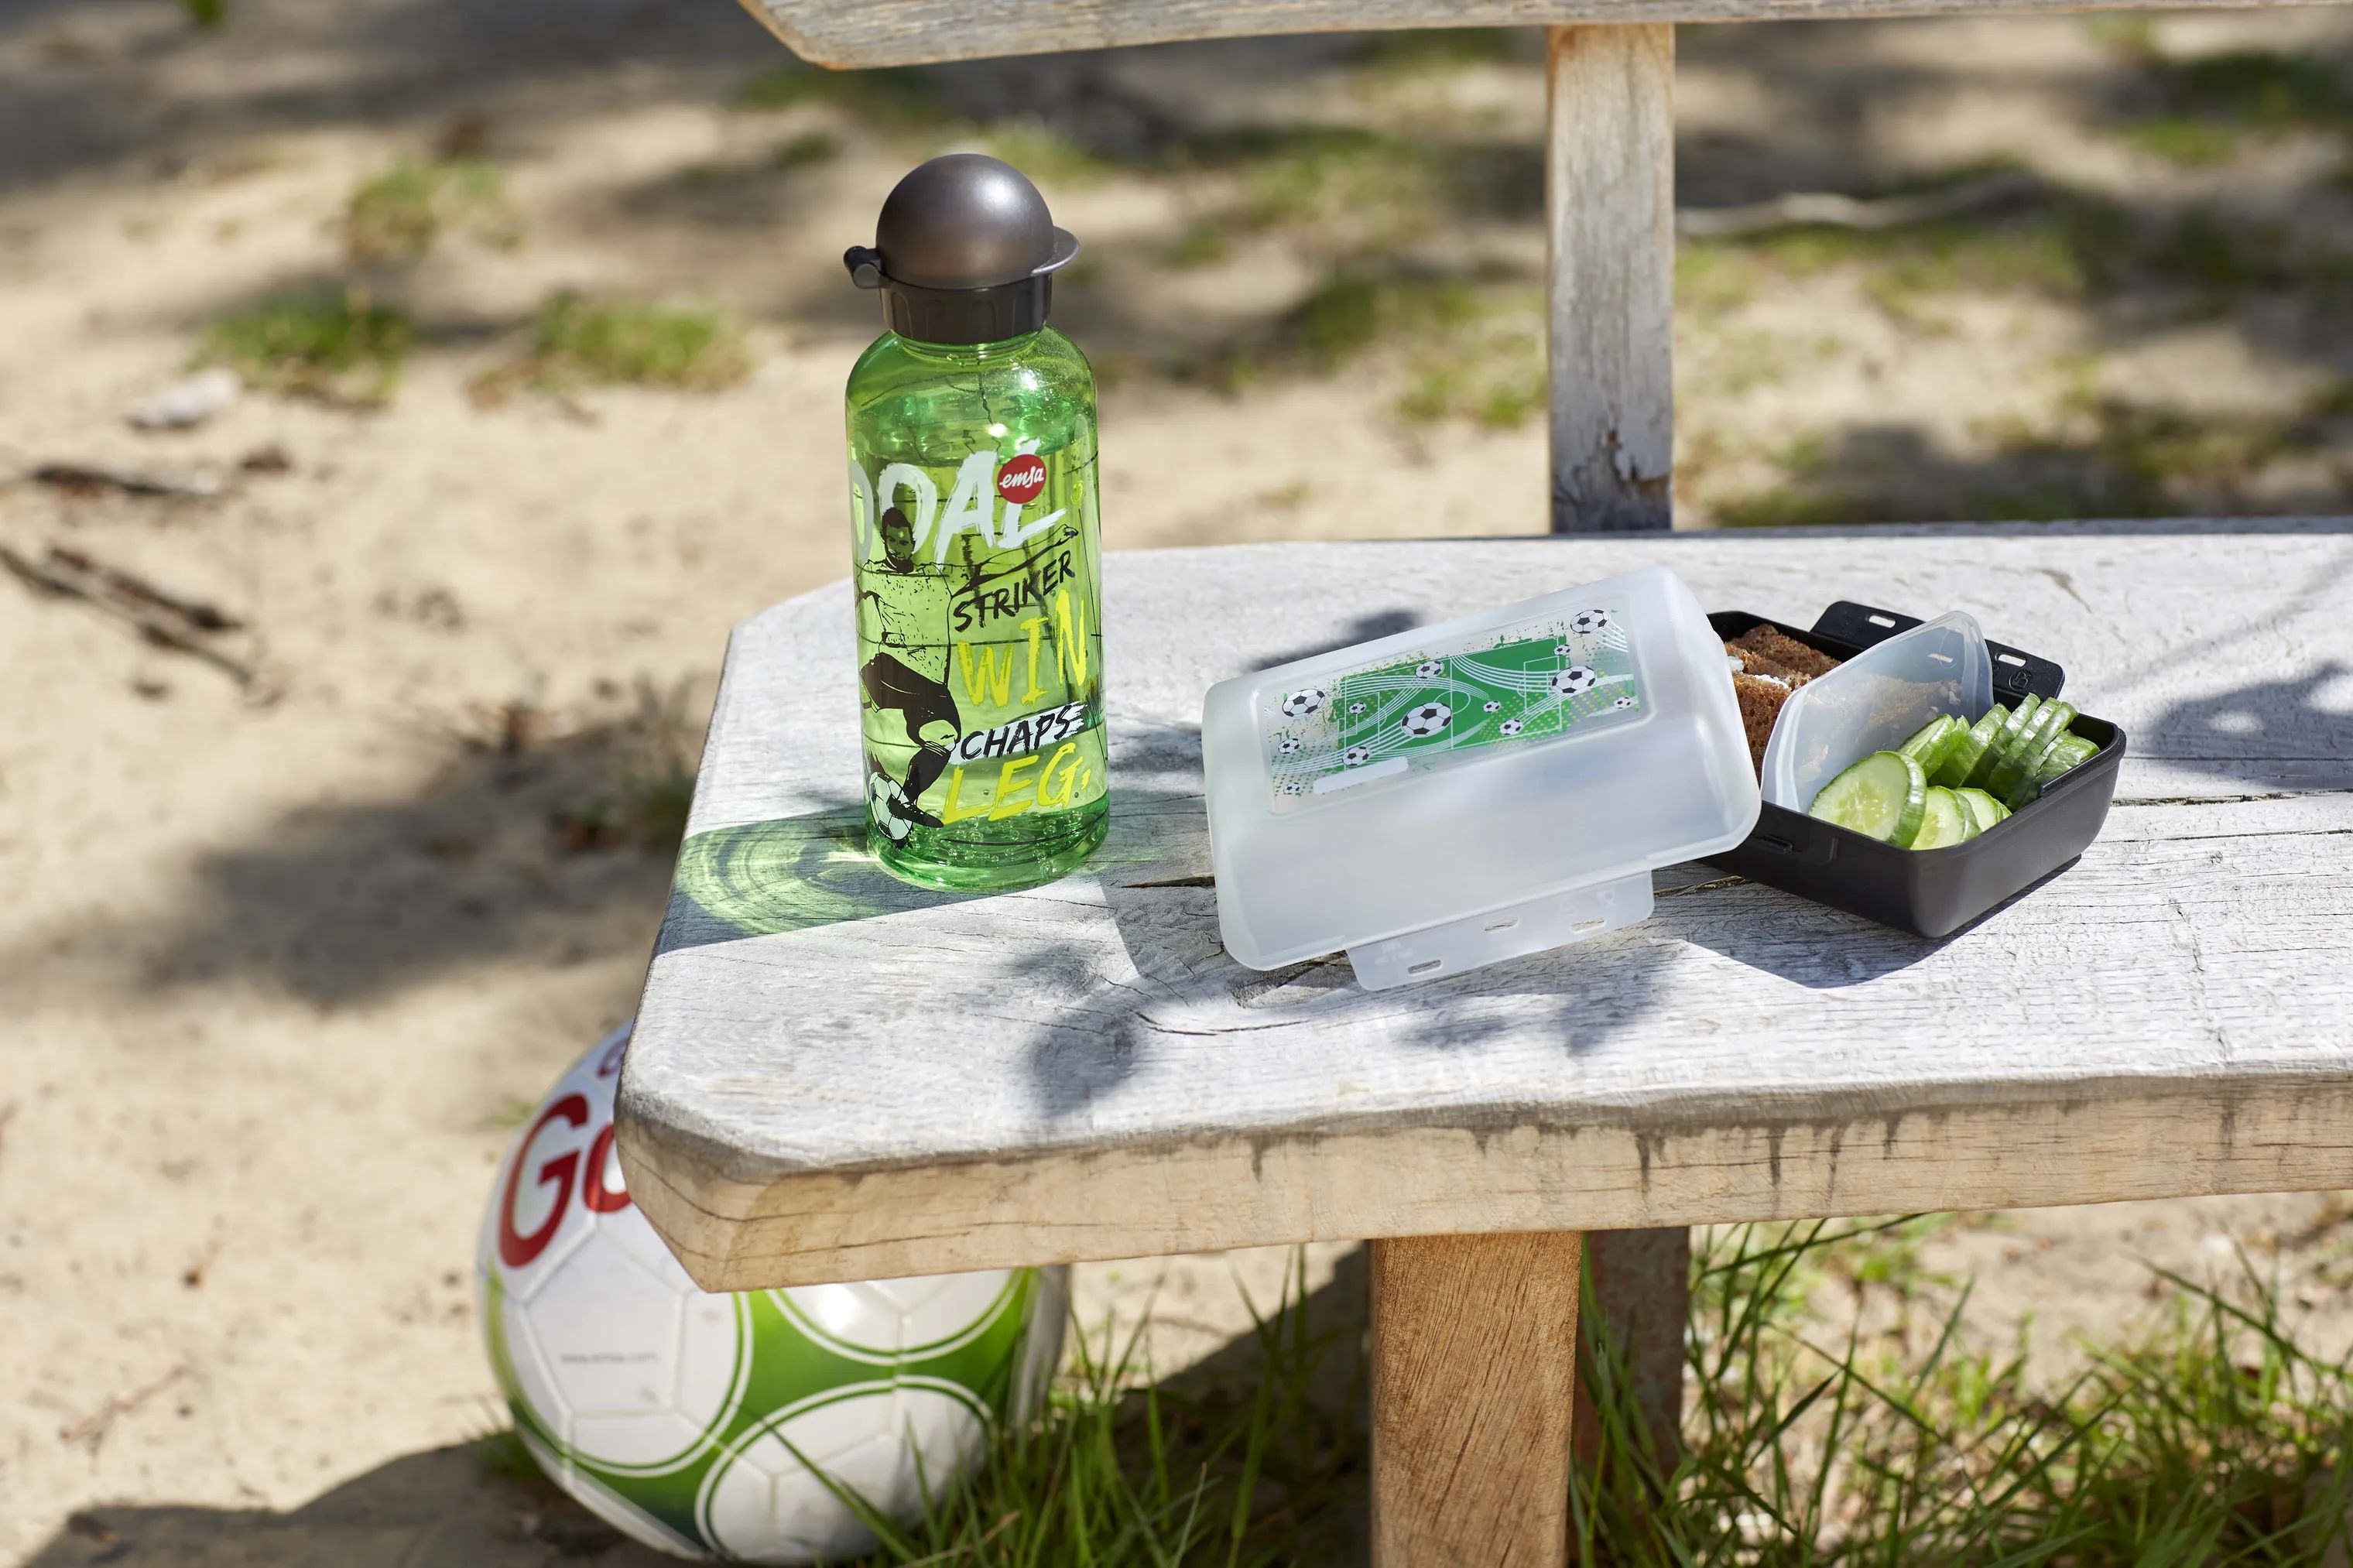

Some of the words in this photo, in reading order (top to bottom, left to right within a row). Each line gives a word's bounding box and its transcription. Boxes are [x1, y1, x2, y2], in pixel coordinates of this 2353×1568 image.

[999, 466, 1044, 489] emsa
[954, 550, 1076, 632] STRIKER
[957, 589, 1087, 709] WIN
[961, 704, 1071, 760] CHAPS
